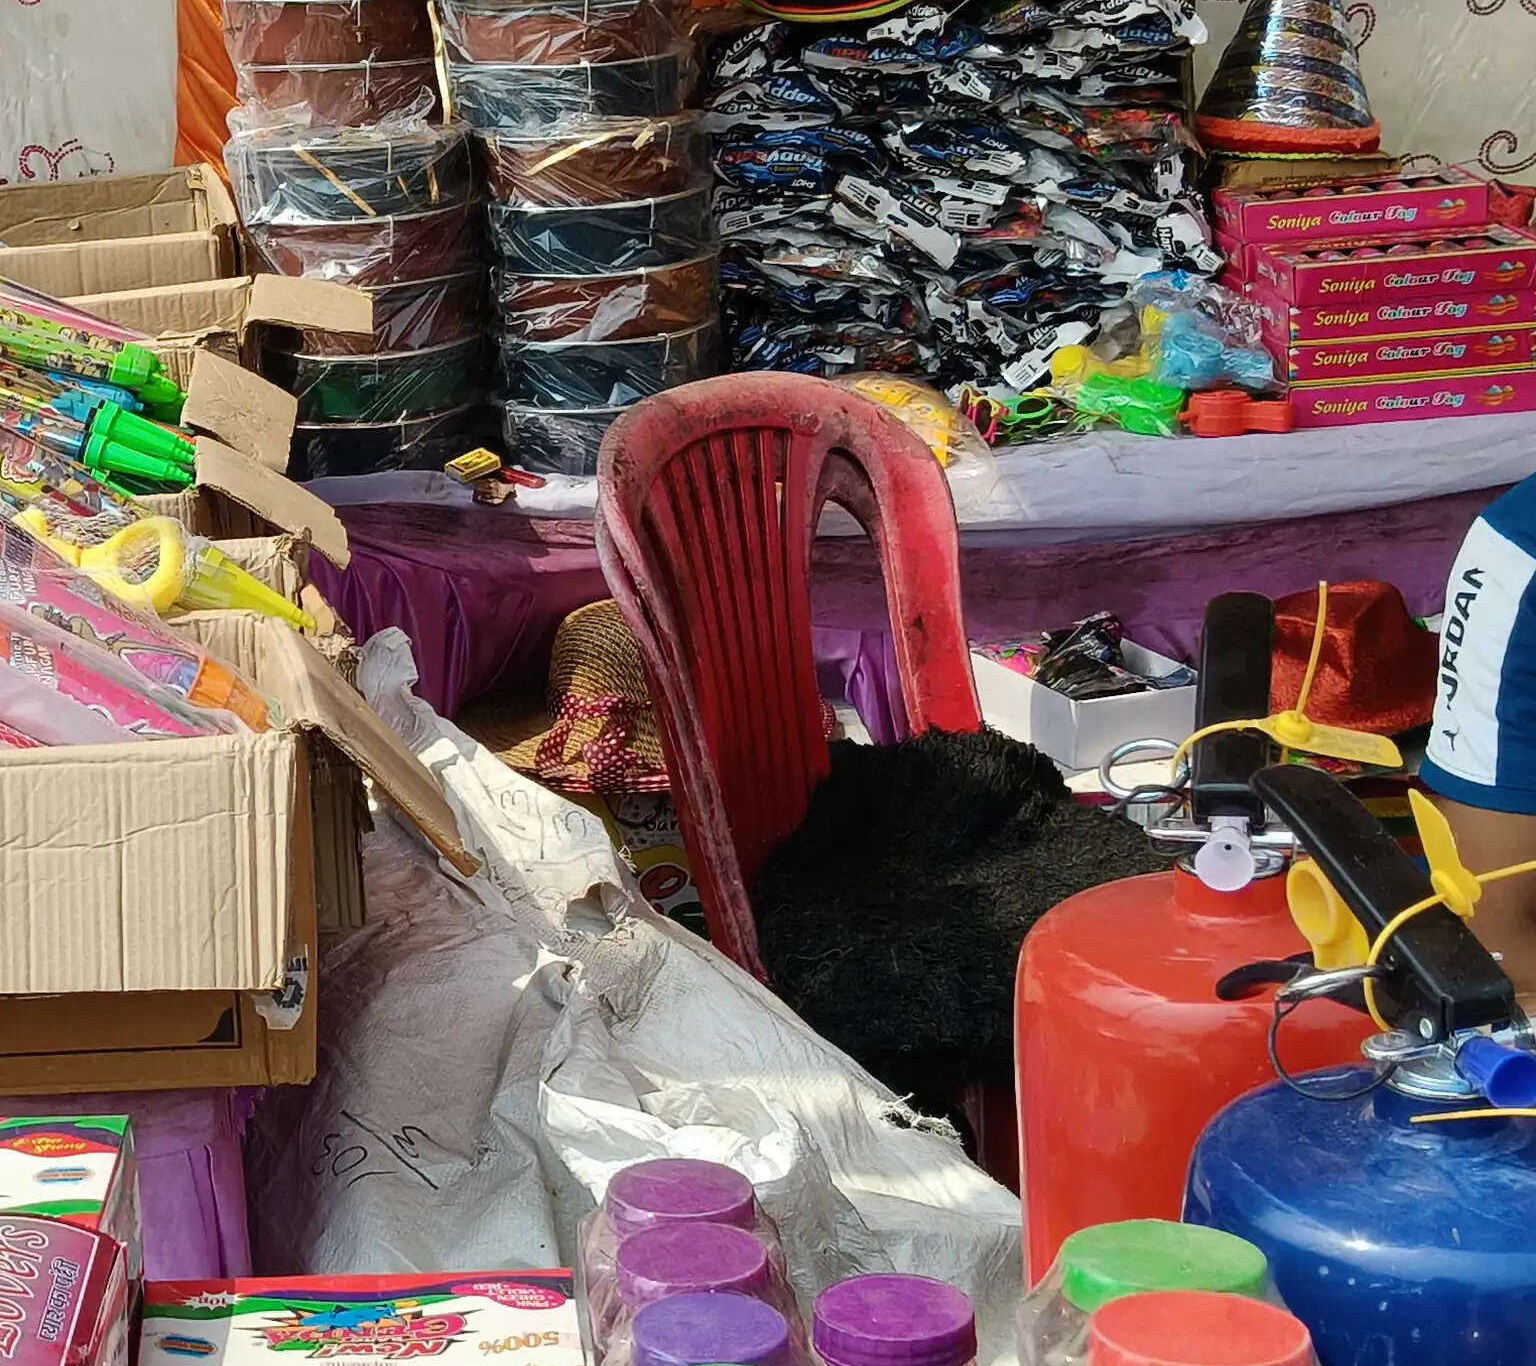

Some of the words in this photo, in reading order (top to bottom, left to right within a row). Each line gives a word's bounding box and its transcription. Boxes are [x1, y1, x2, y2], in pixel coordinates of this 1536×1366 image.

[1267, 214, 1322, 230] Soniya
[1328, 209, 1383, 224] Colour
[1319, 277, 1376, 294] Soniya
[1384, 273, 1439, 287] Colour
[1313, 310, 1369, 327] Soniya
[1377, 306, 1432, 320] Colour
[1313, 350, 1369, 368] Soniya
[1376, 346, 1430, 360] Colour
[1312, 399, 1368, 415] Soniya
[1376, 395, 1429, 409] Colour
[472, 1282, 504, 1291] RED
[487, 1287, 537, 1296] VIOLET
[38, 1306, 62, 1342] प्यार
[50, 1285, 69, 1315] का
[307, 1339, 448, 1359] New!
[478, 1330, 561, 1355] 500%
